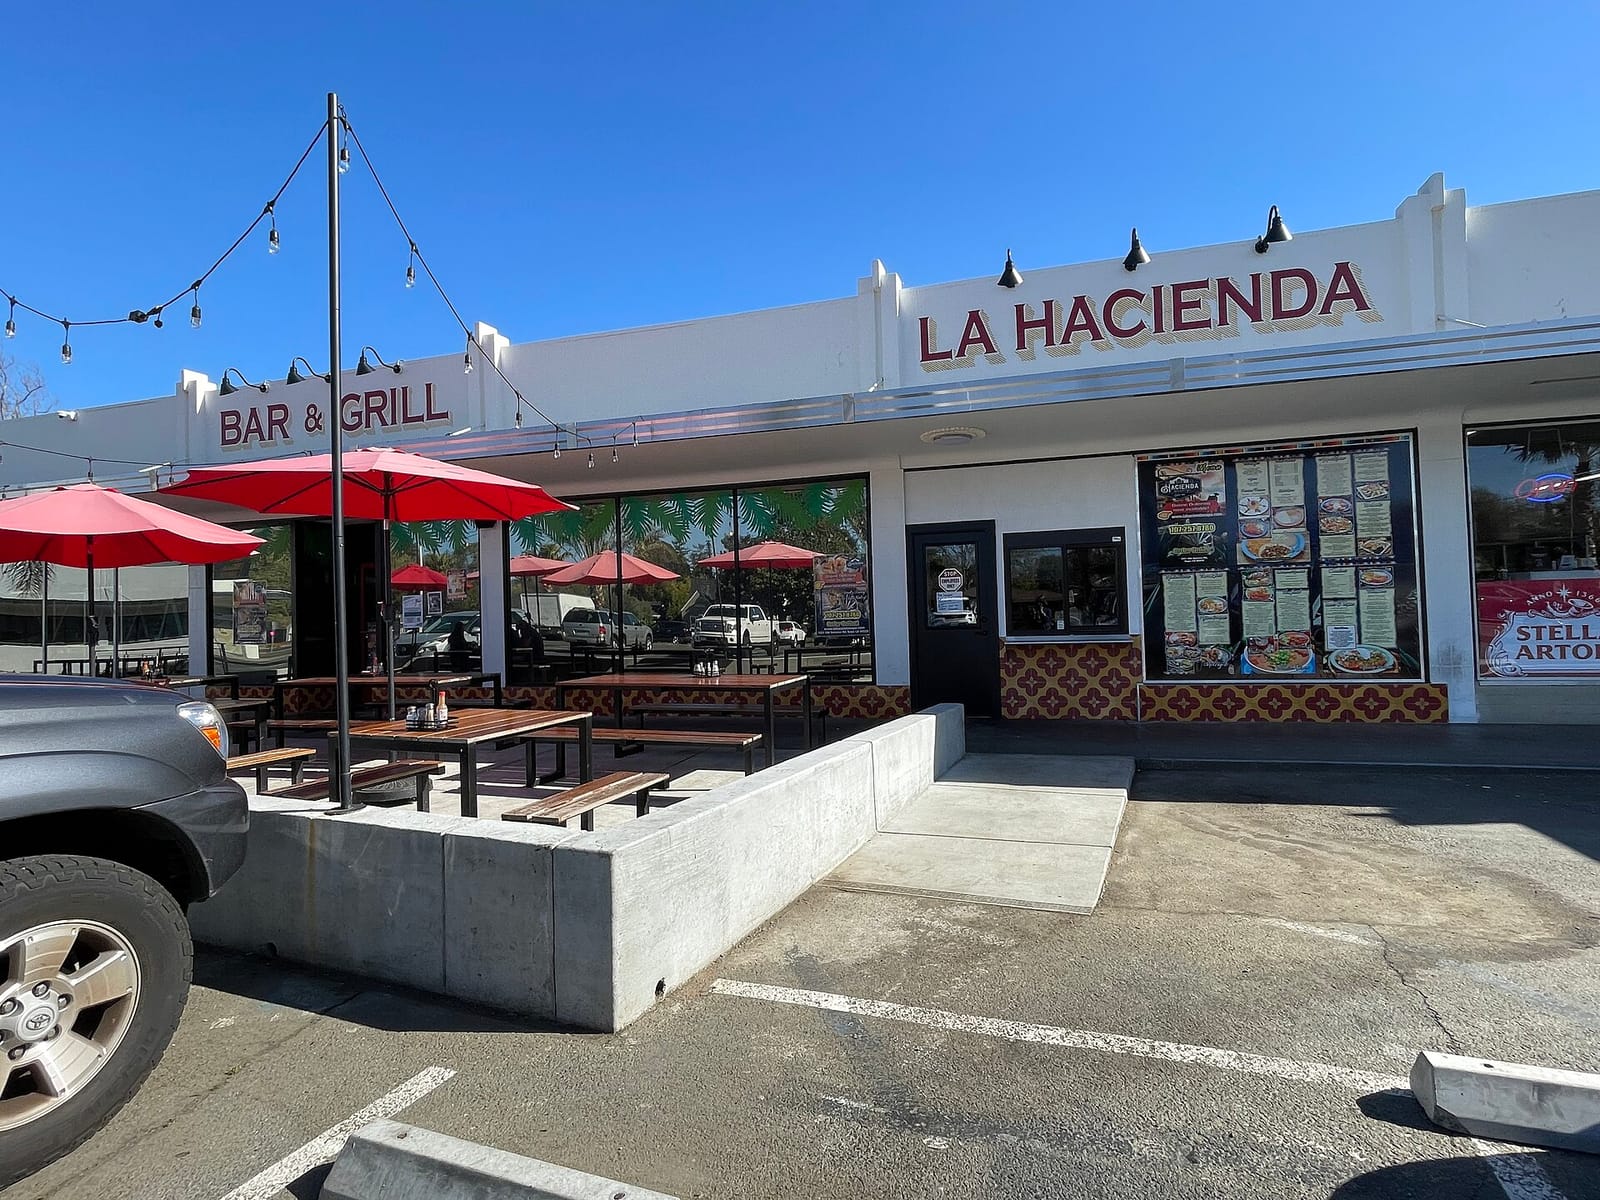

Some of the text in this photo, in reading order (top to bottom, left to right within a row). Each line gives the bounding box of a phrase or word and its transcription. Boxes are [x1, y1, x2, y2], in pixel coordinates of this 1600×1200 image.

[919, 261, 1371, 362] LA HACIENDA
[220, 383, 449, 446] BAR & GRILL
[1161, 482, 1199, 493] HACIENDA
[1526, 590, 1553, 606] ANNO
[1576, 590, 1600, 603] 1366
[1516, 624, 1600, 641] STELL
